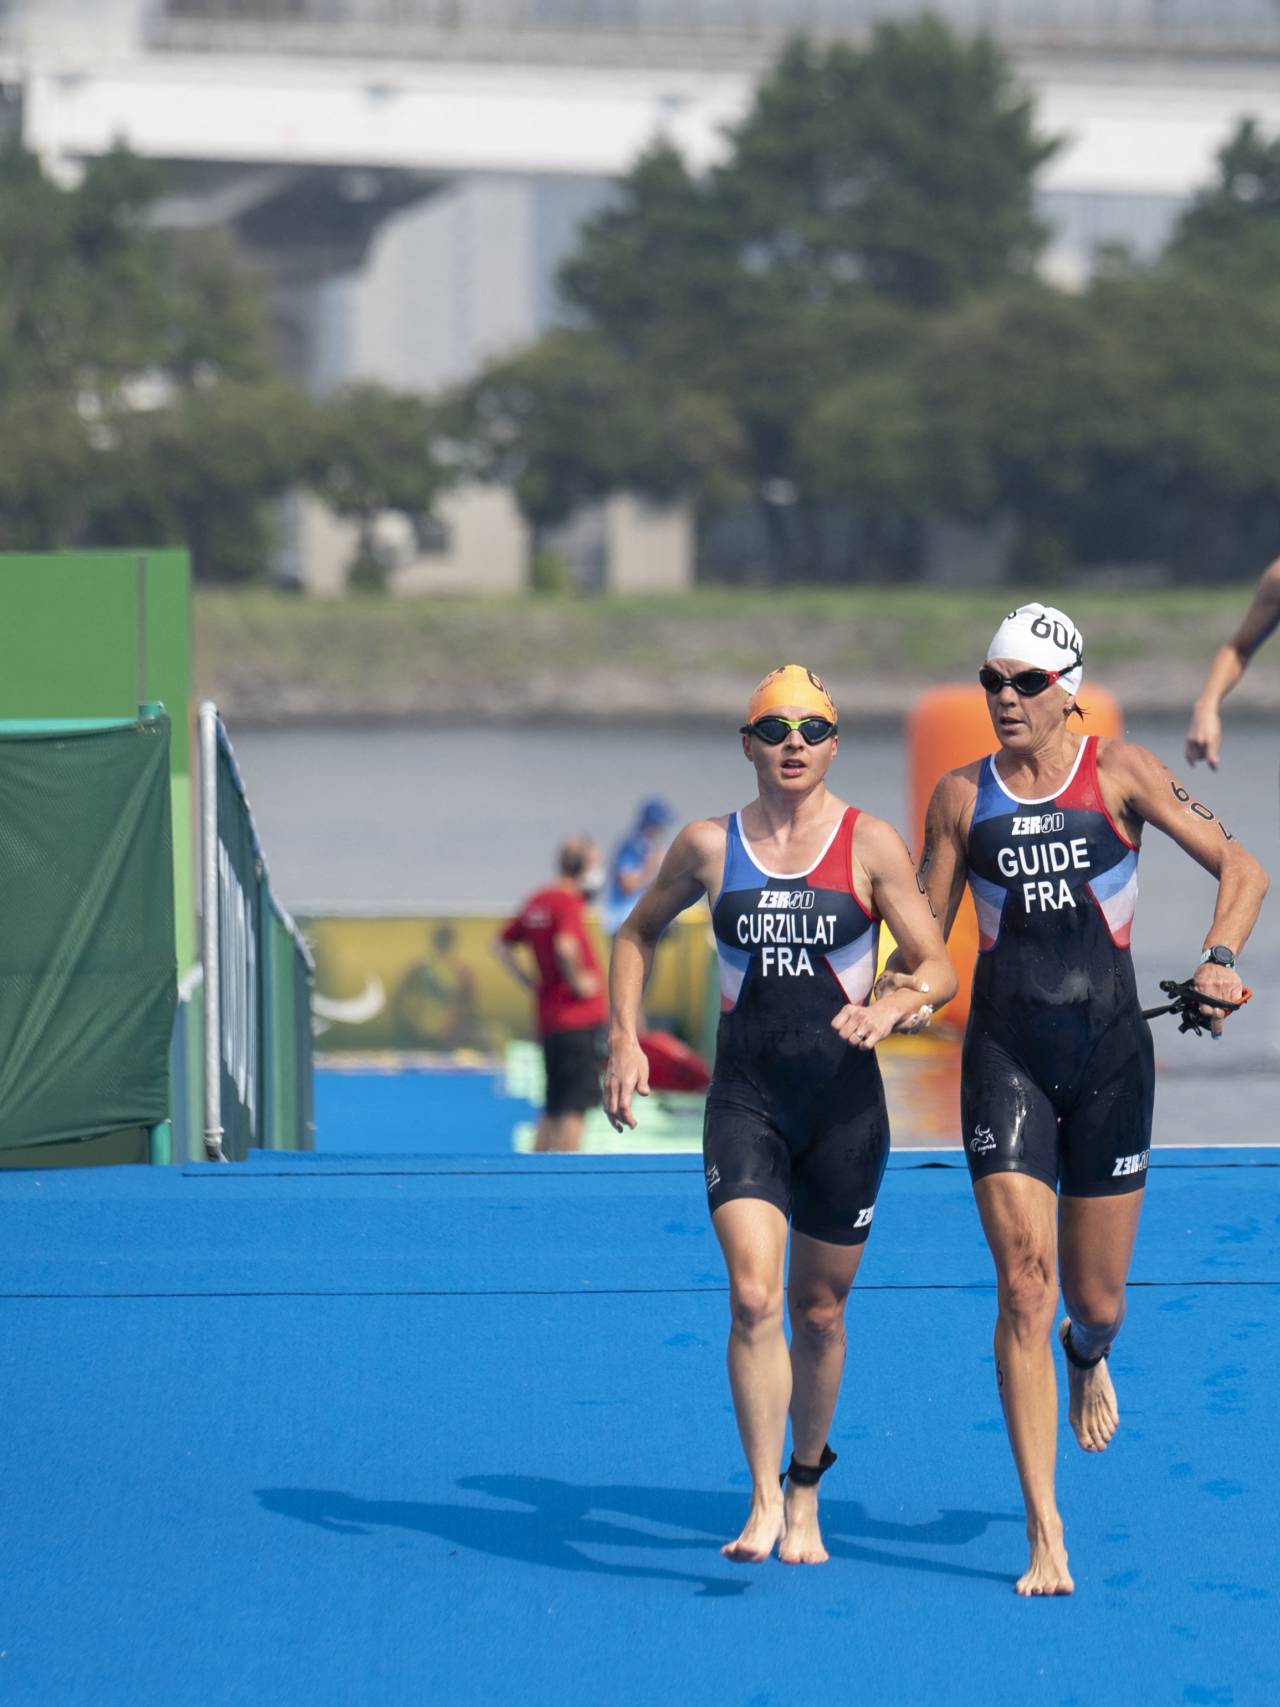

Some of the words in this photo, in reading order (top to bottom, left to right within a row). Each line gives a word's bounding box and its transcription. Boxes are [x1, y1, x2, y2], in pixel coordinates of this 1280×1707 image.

[997, 838, 1090, 877] GUIDE
[1023, 879, 1077, 913] FRA
[737, 914, 837, 945] CURZILLAT
[762, 947, 814, 977] FRA
